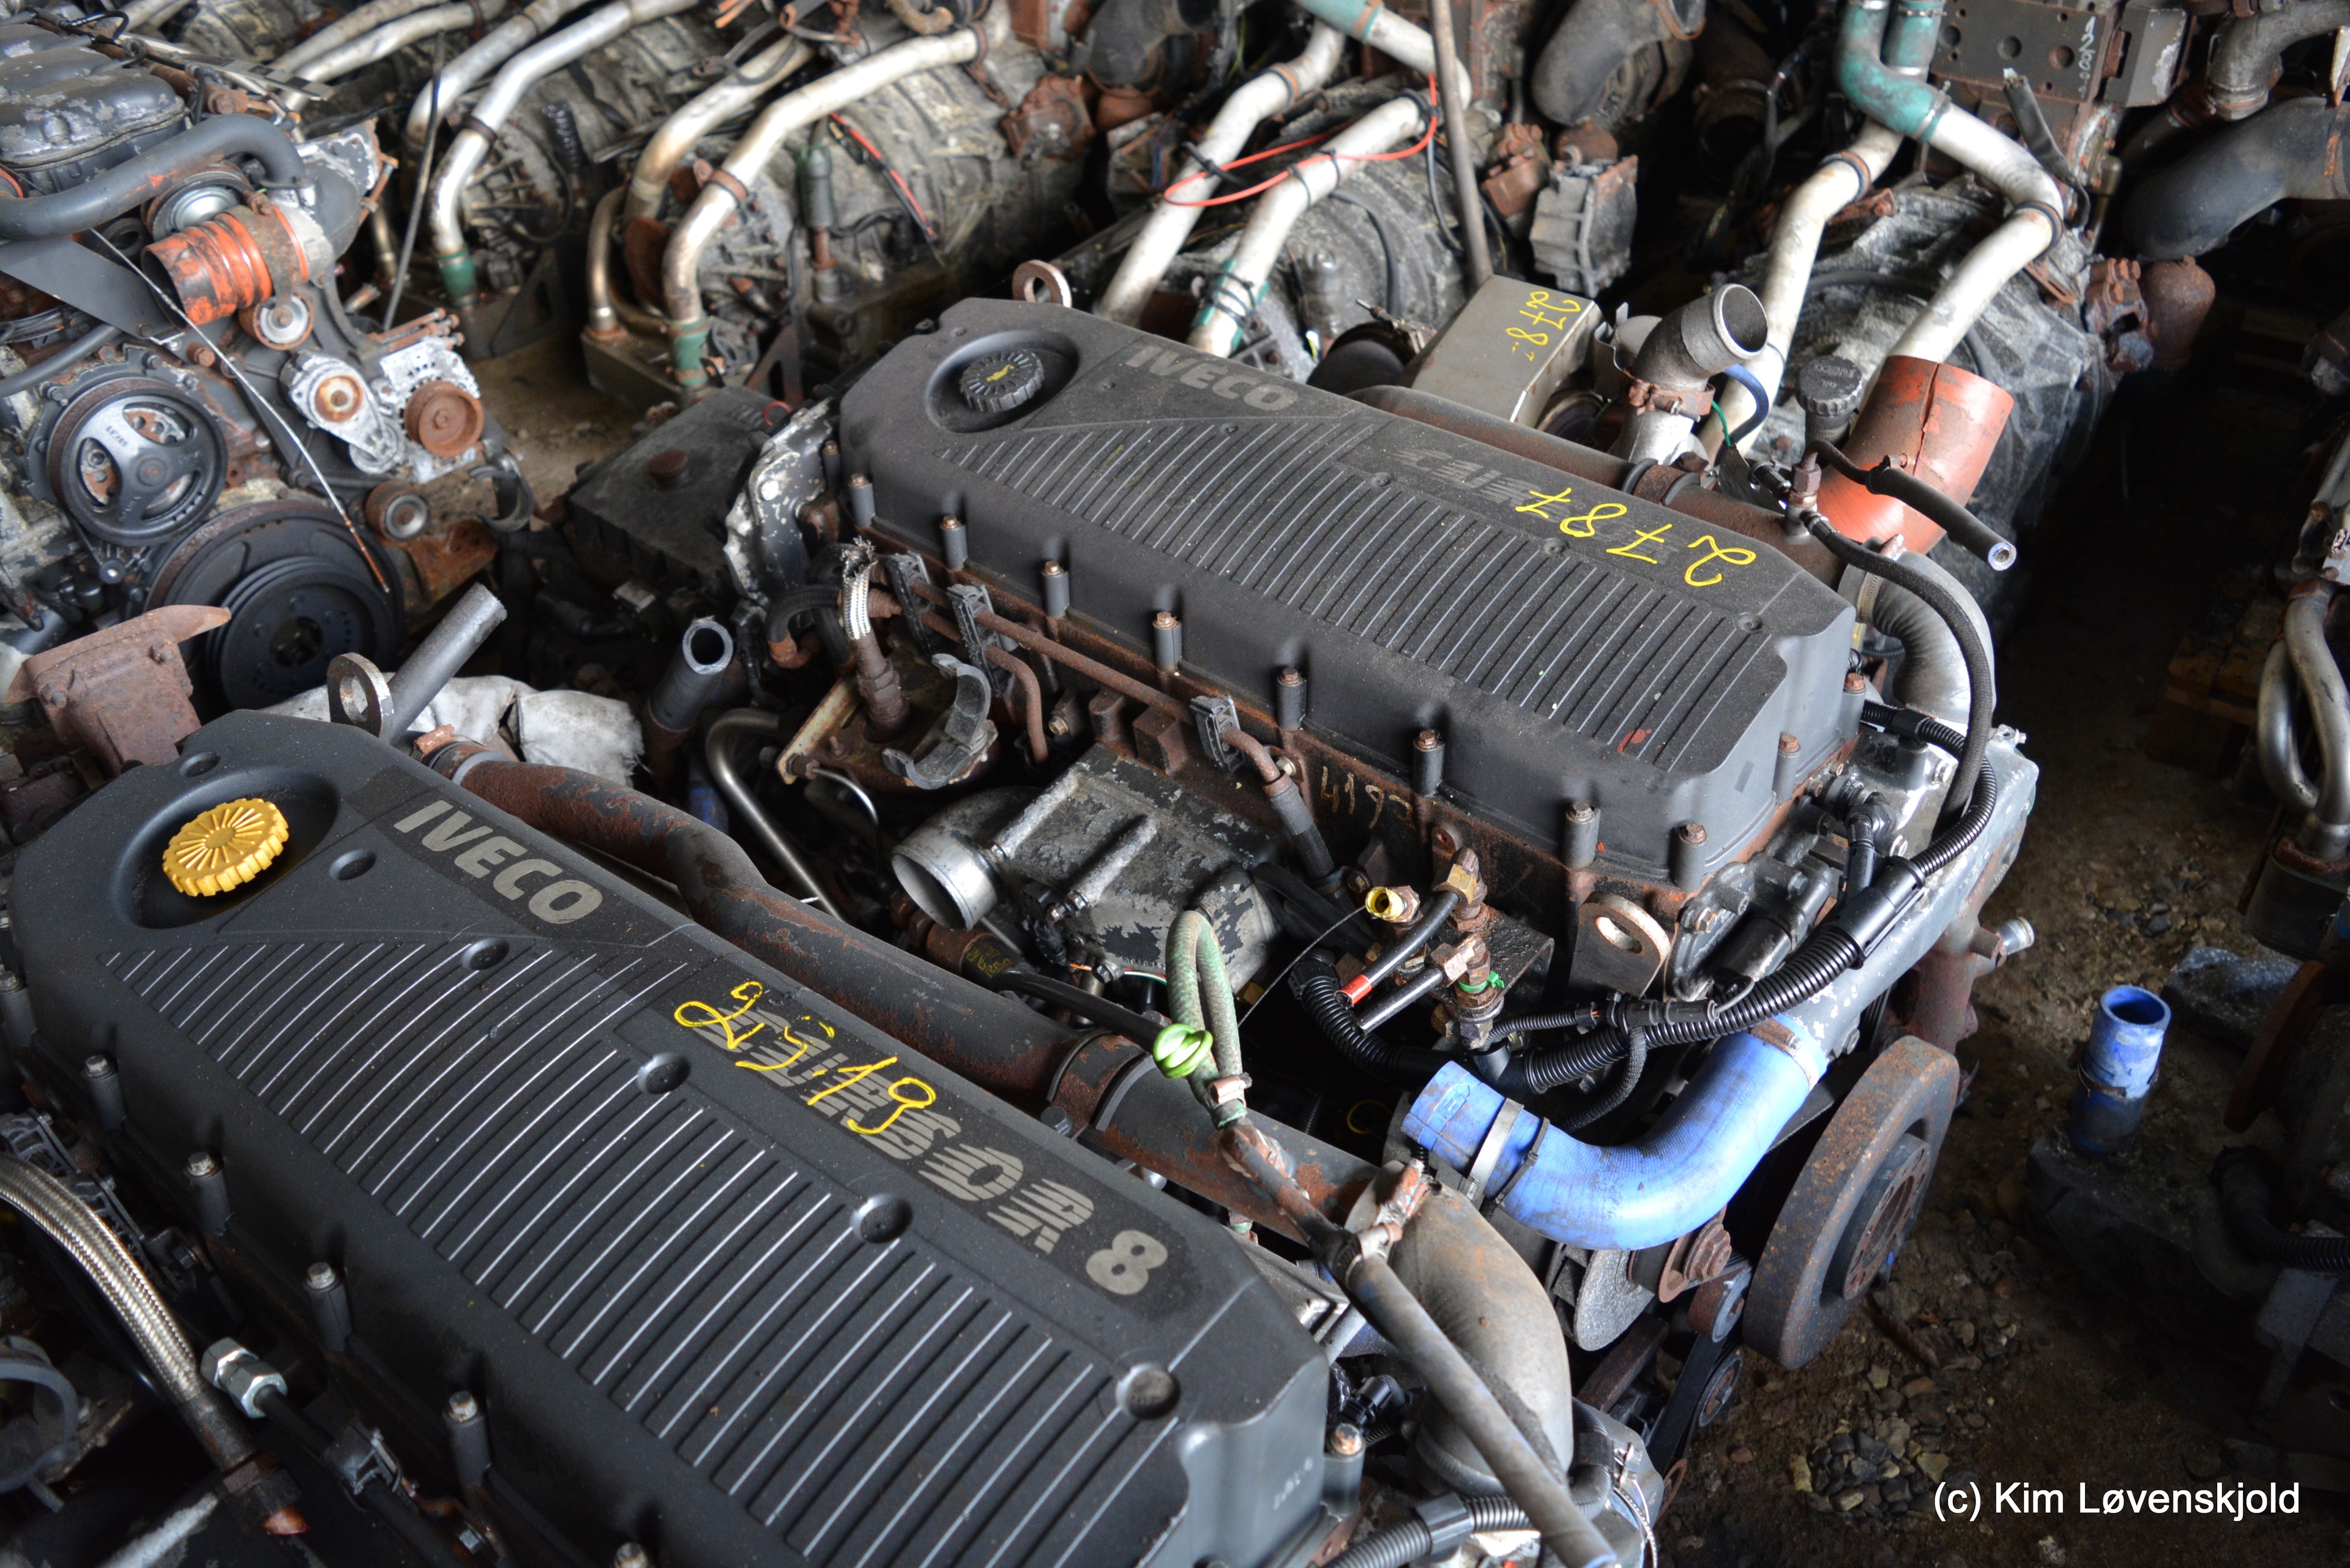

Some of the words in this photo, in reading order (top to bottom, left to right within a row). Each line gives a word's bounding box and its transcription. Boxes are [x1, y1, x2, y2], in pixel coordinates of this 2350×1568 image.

[1125, 345, 1299, 411] IVECO
[1515, 488, 1757, 587] 2787
[394, 800, 603, 924] IVECO
[692, 1006, 1094, 1255] CURSOR
[1086, 1230, 1168, 1296] 8
